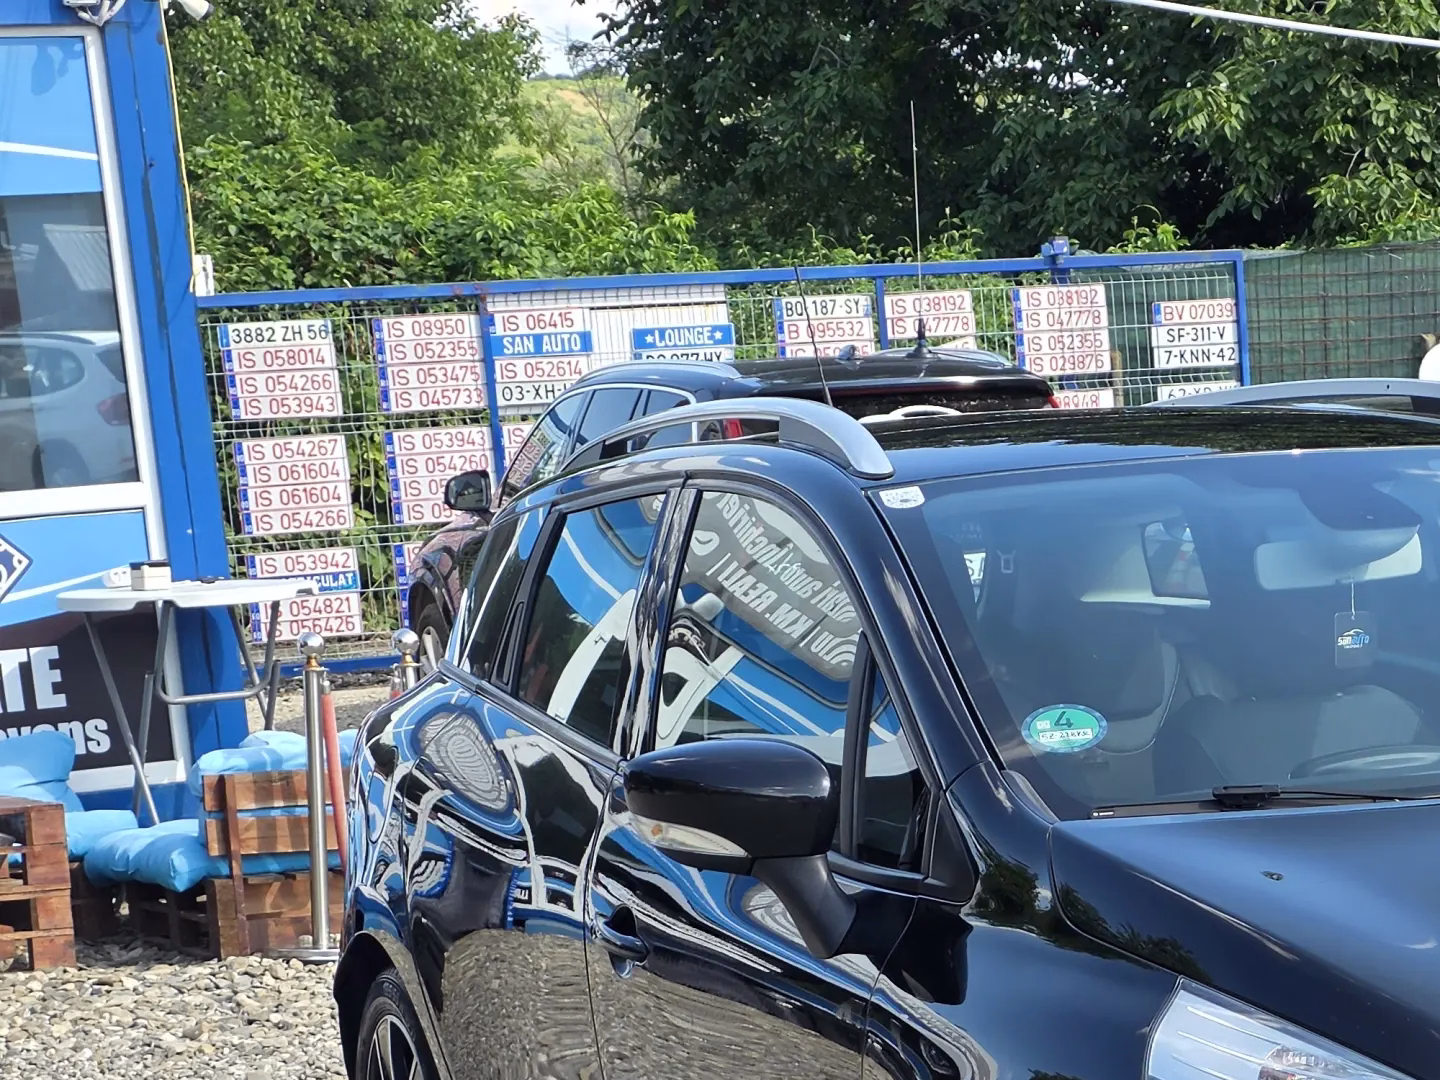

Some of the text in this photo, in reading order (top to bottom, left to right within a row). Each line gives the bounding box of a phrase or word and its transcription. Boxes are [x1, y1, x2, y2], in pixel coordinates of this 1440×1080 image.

[891, 298, 907, 315] IS
[1026, 288, 1099, 308] IS 038192
[502, 311, 574, 332] IS 06415
[1026, 309, 1101, 329] IS 047778
[1163, 305, 1185, 321] BV
[232, 324, 328, 344] 3882 ZH 56
[387, 318, 465, 338] IS 08950
[654, 326, 714, 347] LOUNGE
[787, 321, 864, 340] B 095532
[891, 317, 907, 336] IS
[1167, 326, 1226, 343] SF-311-V
[389, 344, 407, 361] IS
[503, 333, 581, 354] SAN AUTO
[1027, 336, 1042, 353] IS
[237, 348, 325, 369] IS 058014
[1029, 353, 1105, 374] IS 029876
[1164, 347, 1236, 364] 7-KNN-42
[391, 365, 480, 386] IS 053475
[500, 360, 582, 380] IS 052614
[240, 373, 332, 394] IS 054266
[244, 396, 335, 416] IS 053943
[395, 388, 484, 409] IS 045733
[398, 430, 486, 451] IS 053943
[508, 427, 526, 445] IS
[247, 439, 338, 461] IS 054267
[253, 461, 340, 484] IS 061604
[400, 458, 418, 475] IS
[254, 485, 341, 508] IS 061604
[403, 480, 422, 498] IS
[255, 509, 347, 531] IS 054266
[407, 504, 425, 521] IS
[259, 552, 351, 575] IS 053942
[289, 596, 352, 618] 054821
[1054, 711, 1073, 728] 4
